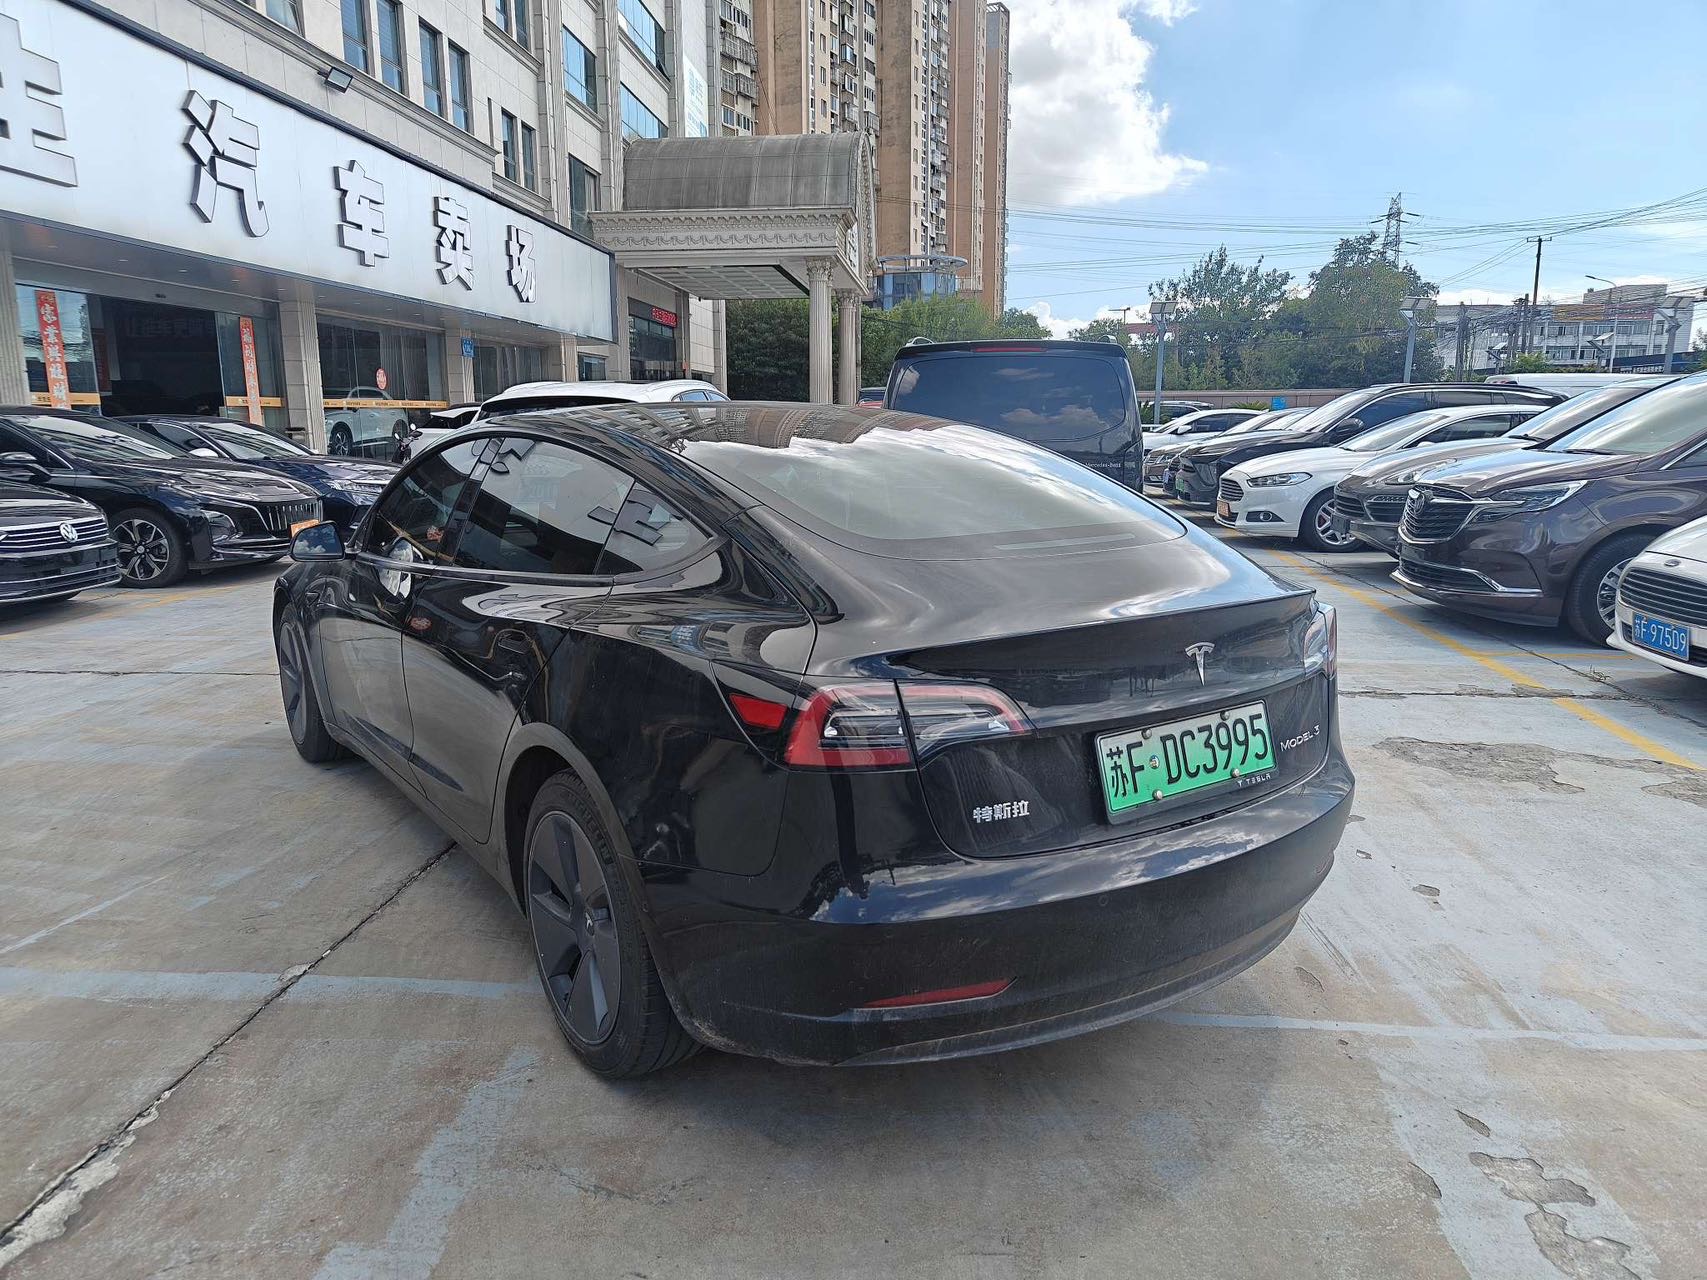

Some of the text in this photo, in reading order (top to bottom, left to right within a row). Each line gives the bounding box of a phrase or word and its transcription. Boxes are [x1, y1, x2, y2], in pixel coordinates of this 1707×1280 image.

[1280, 731, 1313, 752] MODEL
[1246, 773, 1271, 784] TESLA
[972, 799, 1030, 824] 特斯拉
